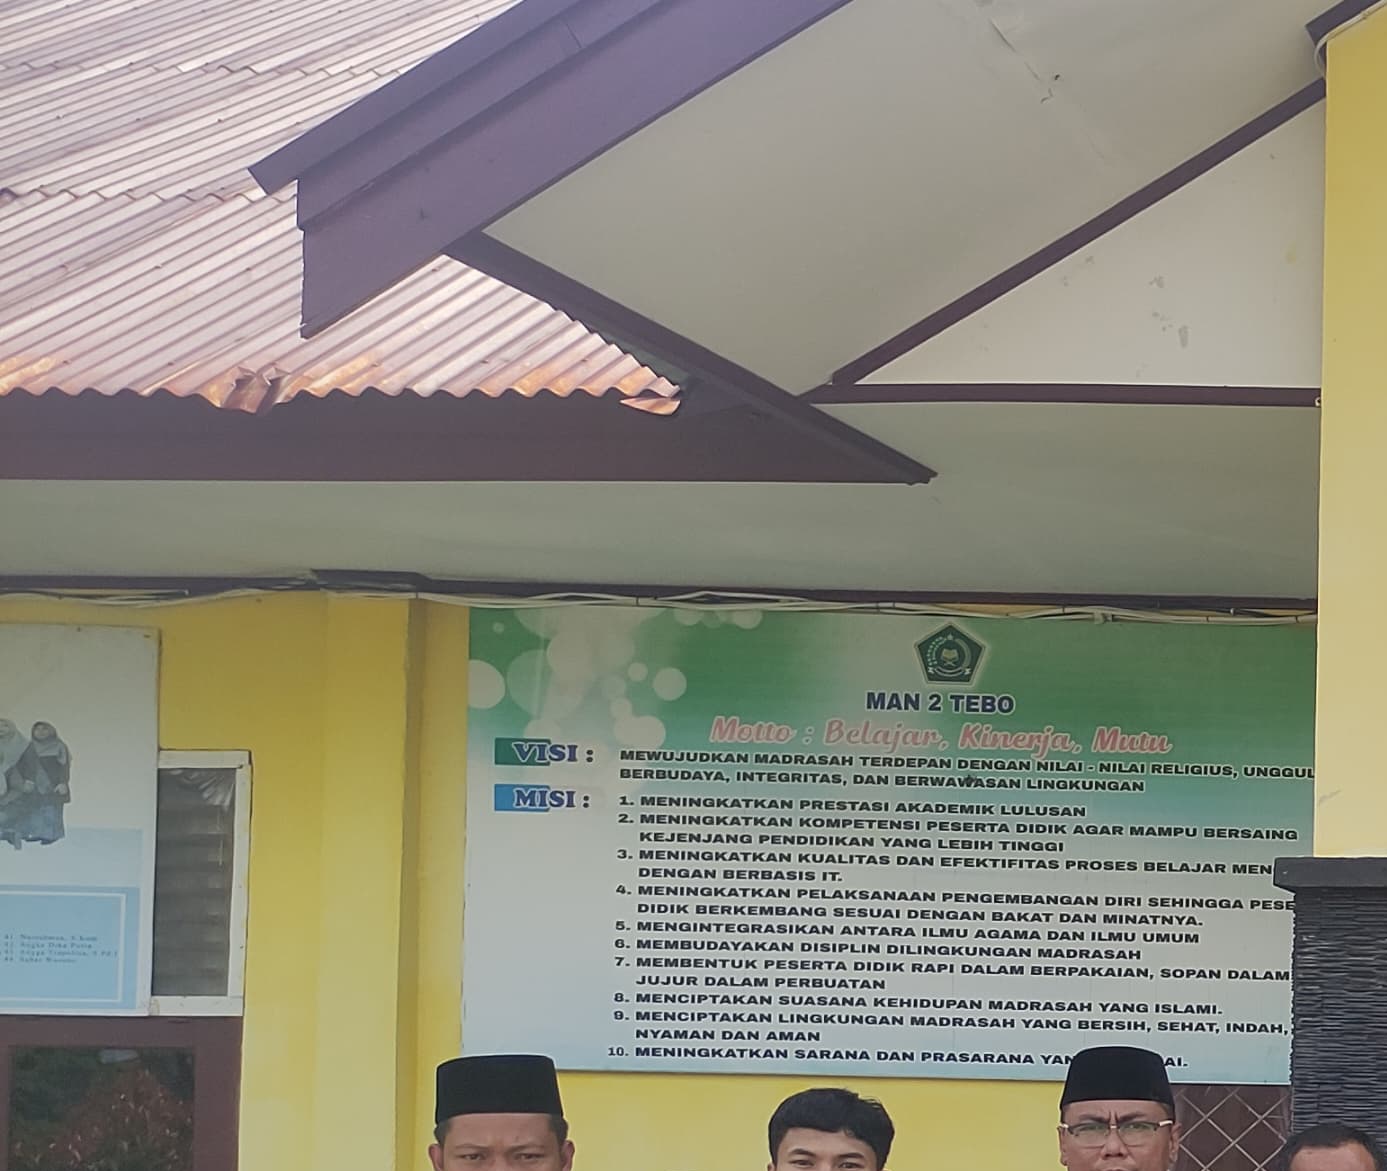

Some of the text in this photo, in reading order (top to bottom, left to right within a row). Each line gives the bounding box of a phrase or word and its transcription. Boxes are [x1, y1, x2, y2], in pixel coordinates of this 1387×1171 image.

[866, 692, 1014, 714] MAN 2 TEBO
[710, 717, 793, 743] Motto
[824, 718, 948, 753] Belajar,
[959, 723, 1082, 759] Kinerja,
[1092, 727, 1172, 753] Mutu
[513, 742, 578, 762] VISI
[620, 750, 748, 763] MEWUJUDKAN
[754, 753, 853, 766] MADRASAH
[858, 756, 951, 768] TERDEPAN
[957, 759, 1030, 771] DENGAN
[1036, 761, 1082, 772] NILAI
[1098, 762, 1145, 773] NILAI
[1151, 763, 1237, 778] RELIGIUS,
[620, 768, 1144, 791] BERBUDAYA, INTEGRITAS, DAN BERWAWASAN LINGKUNGAN
[514, 788, 577, 808] MISI
[619, 795, 1085, 817] 1. MENINGKATKAN PRESTASI AKADEMIK LULUSAN
[618, 813, 1297, 840] 2. MENINGKATKAN KOMPETENSI PESERTA DIDIK AGAR MAMPU BERSAING
[639, 832, 1063, 852] KEJENJANG PENDIDIKAN YANG LEBIH TINGGI
[615, 920, 1199, 943] 5. MENGINTEGRASIKAN ANTARA ILMU AGAMA DAN ILMU UMUM
[614, 992, 1222, 1014] 8. MENCIPTAKAN SUASANA KEHIDUPAN MADRASAH YANG ISLAMI.
